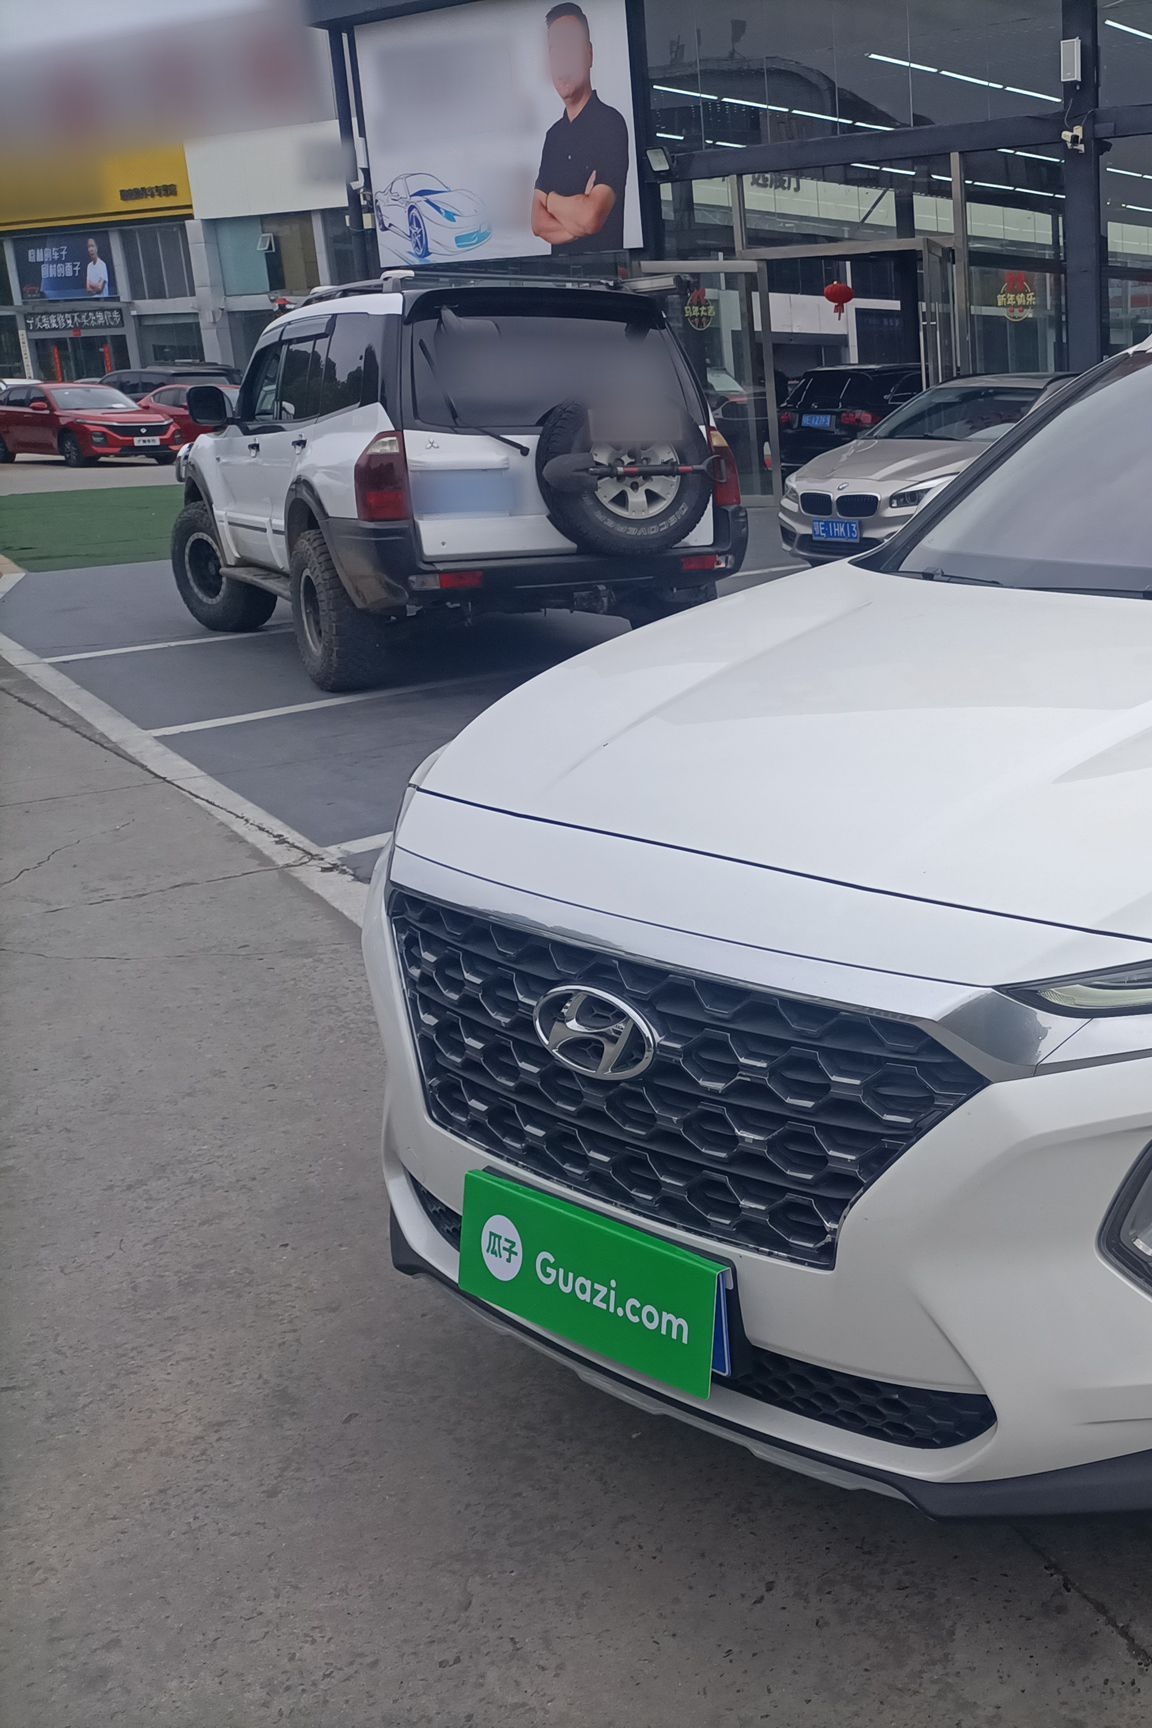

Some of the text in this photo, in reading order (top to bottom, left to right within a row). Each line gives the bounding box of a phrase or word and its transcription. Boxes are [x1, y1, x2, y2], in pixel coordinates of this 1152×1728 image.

[997, 292, 1036, 306] 新年快乐
[485, 1230, 519, 1264] 瓜子
[535, 1250, 690, 1345] Guazi.com
